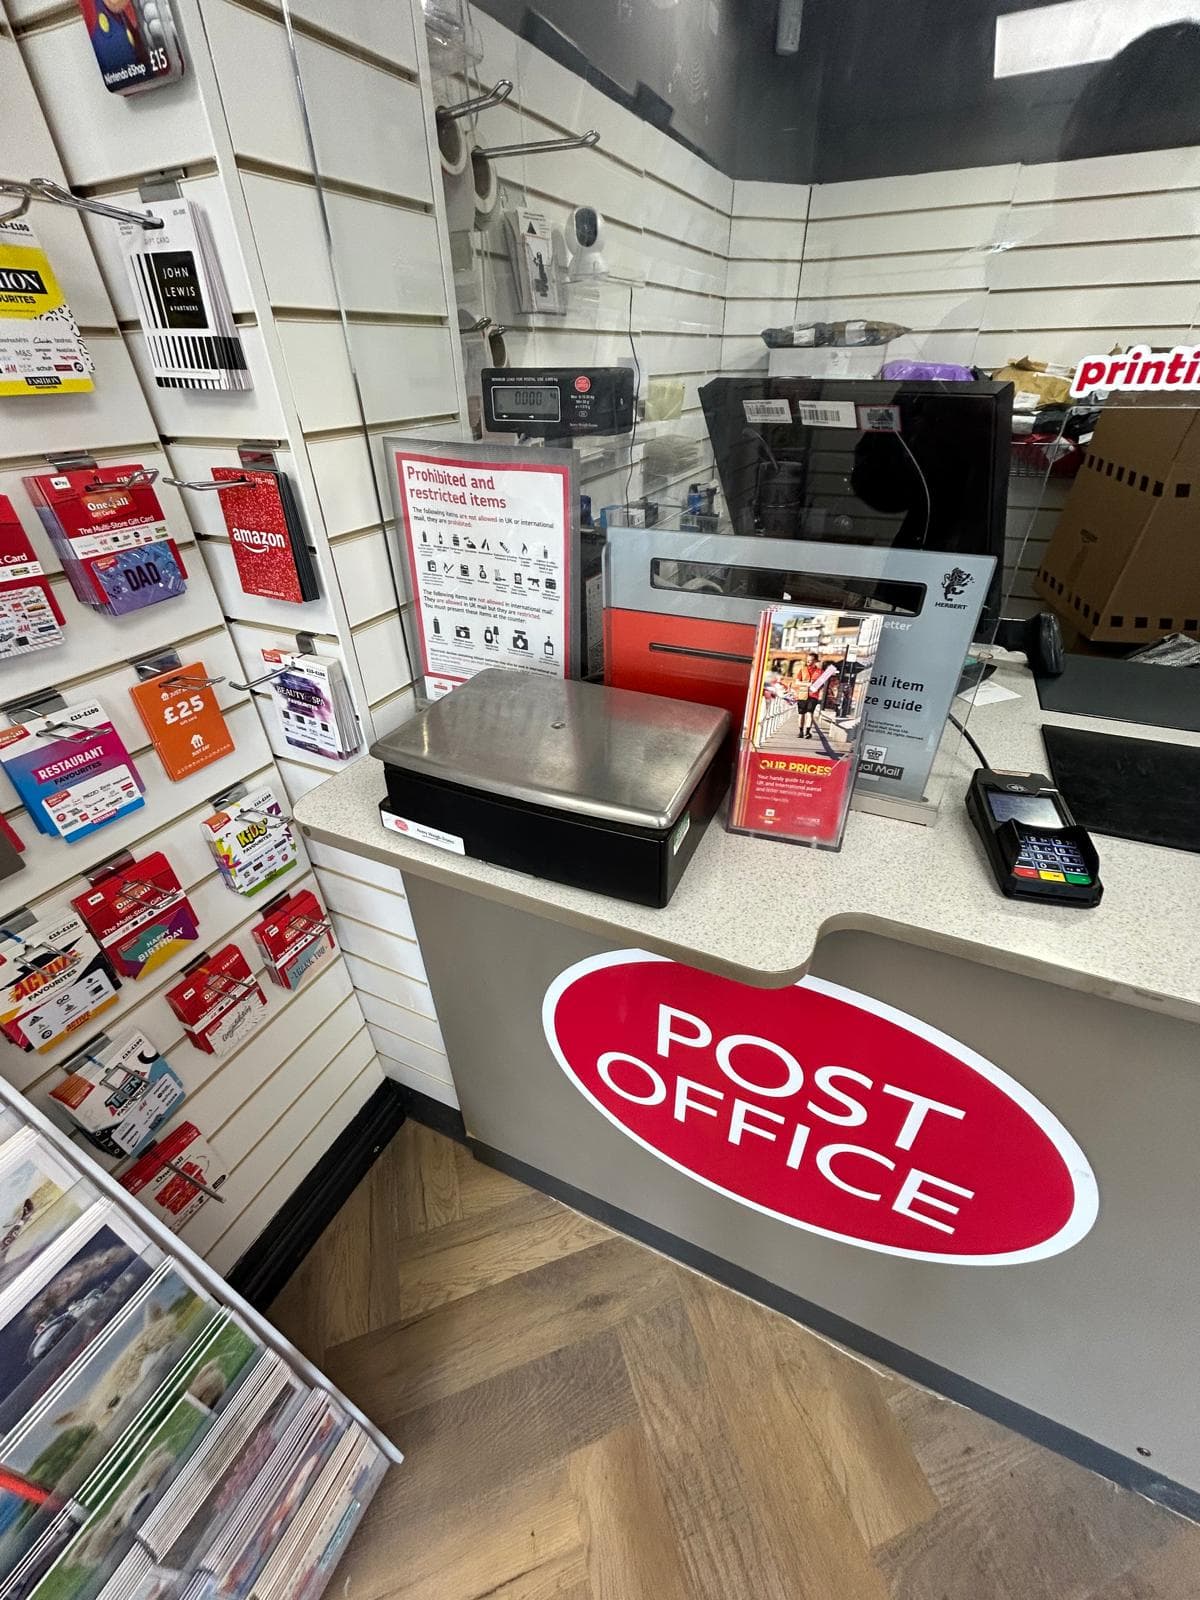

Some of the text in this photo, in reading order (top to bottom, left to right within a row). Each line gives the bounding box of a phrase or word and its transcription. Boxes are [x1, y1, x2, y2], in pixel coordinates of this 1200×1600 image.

[149, 47, 168, 72] £15
[103, 63, 146, 86] Nintendo eShop
[0, 270, 41, 291] ION
[162, 266, 189, 280] JOHN
[165, 285, 196, 298] LEWIS
[174, 304, 199, 312] PARTNERS
[1076, 351, 1200, 392] printi
[406, 466, 496, 491] Prohibited and
[409, 487, 507, 509] restricted items
[91, 510, 102, 518] Gift
[423, 507, 445, 517] following
[478, 514, 497, 523] allowed
[521, 519, 554, 529] international
[426, 516, 437, 524] they
[78, 528, 93, 536] The
[92, 521, 128, 533] Multi-Store
[128, 517, 140, 526] Gift
[140, 515, 155, 523] Card
[232, 527, 286, 549] amazon
[3, 552, 28, 564] Card
[123, 562, 162, 592] DAD
[424, 595, 435, 603] They
[497, 606, 507, 615] they
[433, 590, 454, 599] following
[510, 602, 541, 613] international
[446, 606, 465, 614] present
[934, 601, 968, 610] HERBERT
[870, 675, 924, 692] ail item
[276, 685, 326, 707] BEAUTY SPA
[864, 695, 923, 713] ze guide
[70, 707, 99, 722] £15-£100
[163, 694, 205, 725] £25
[191, 743, 211, 757] JUST EAT
[37, 746, 104, 780] RESTAURANT
[53, 761, 103, 785] FAVOURITES
[760, 759, 833, 777] OUR PRICES
[875, 764, 901, 777] Mail
[765, 780, 775, 788] and
[775, 782, 806, 790] international
[806, 785, 822, 793] parcel
[769, 775, 784, 783] handy
[785, 776, 799, 784] guide
[797, 790, 813, 798] prices
[48, 921, 79, 940] £15-£100
[102, 926, 117, 936] The
[146, 929, 170, 948] HAPPY
[137, 927, 185, 962] BIRTHDAY
[27, 969, 78, 1001] FAVOURITES
[656, 1002, 967, 1152] POST
[596, 1051, 976, 1236] OFFICE
[155, 1155, 184, 1184] Oneall
